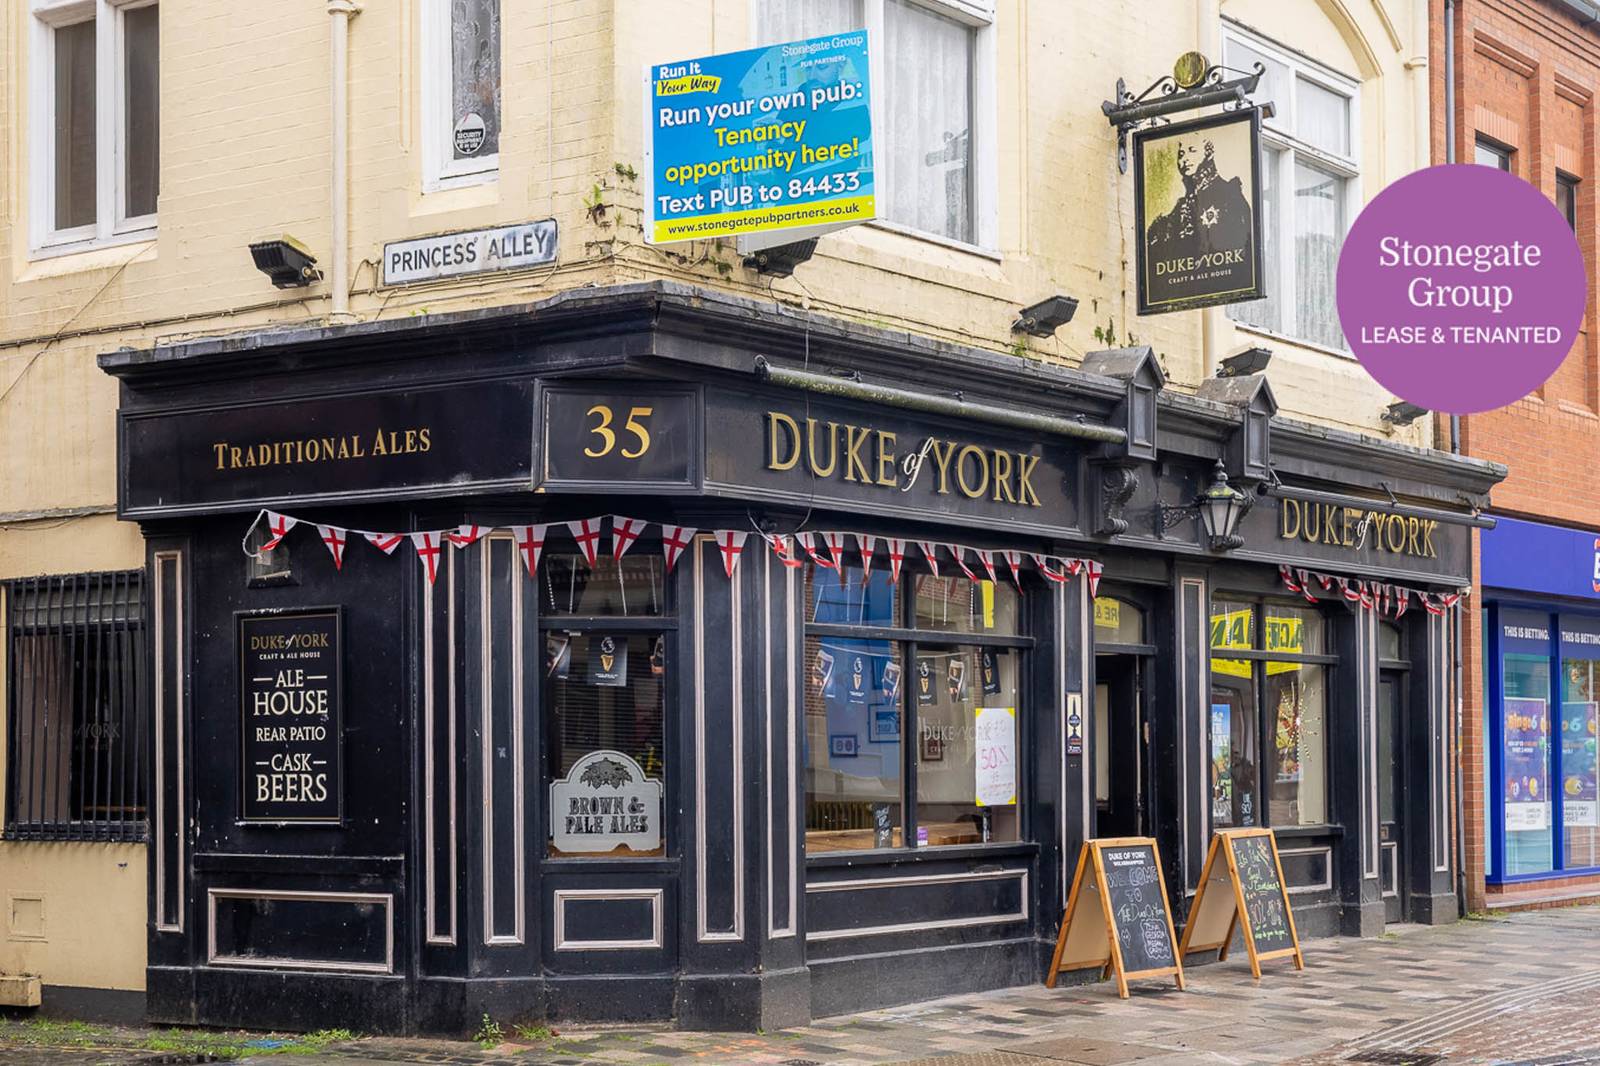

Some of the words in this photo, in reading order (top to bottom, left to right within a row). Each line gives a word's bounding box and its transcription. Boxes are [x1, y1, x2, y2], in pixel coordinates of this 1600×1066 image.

[782, 42, 830, 56] Stonegate
[831, 36, 863, 48] Group
[660, 63, 686, 79] Run
[689, 62, 701, 75] It
[801, 60, 812, 68] PUB
[815, 54, 846, 65] PARTNERS
[660, 79, 687, 94] Your
[690, 77, 717, 93] Way
[659, 107, 700, 128] Run
[705, 99, 755, 126] your
[759, 92, 805, 112] own
[812, 79, 863, 110] pub:
[714, 120, 806, 147] Tenancy
[665, 149, 796, 185] opportunity
[802, 137, 859, 164] here!
[658, 194, 704, 214] Text
[710, 186, 753, 208] PUB
[759, 184, 782, 202] to
[788, 172, 860, 198] 84433
[668, 203, 860, 234] www.stonegatepubpartners.co.uk
[487, 229, 548, 260] ALLEY
[1156, 257, 1194, 275] DUKE
[1203, 248, 1244, 267] YORK
[1168, 276, 1188, 284] CRAFT
[1210, 269, 1232, 278] HOUSE
[583, 405, 654, 458] 35
[213, 437, 364, 470] TRADITIONAL
[372, 428, 431, 456] ALES
[767, 411, 898, 488] DUKE
[901, 436, 935, 492] of
[932, 439, 1042, 507] YORK
[1282, 498, 1357, 546] DUKE
[1356, 511, 1373, 550] of
[1371, 511, 1438, 558] YORK
[251, 635, 285, 650] DUKE
[294, 633, 328, 648] YORK
[1504, 626, 1517, 637] THIS
[1518, 627, 1524, 638] IS
[1524, 627, 1550, 640] BETTING.
[1562, 631, 1574, 642] THIS
[1575, 632, 1580, 643] IS
[275, 670, 304, 688] ALE
[253, 690, 328, 716] HOUSE
[256, 727, 287, 742] REAR
[290, 726, 326, 741] PATIO
[924, 726, 955, 740] DUKE
[271, 754, 312, 772] CASK
[256, 773, 328, 802] BEERS
[568, 796, 624, 815] BROWN
[628, 796, 645, 814] &
[566, 816, 604, 834] PALE
[609, 816, 649, 834] ALES
[1108, 852, 1123, 860] DUKE
[1124, 852, 1130, 860] OF
[1131, 851, 1146, 859] YORK
